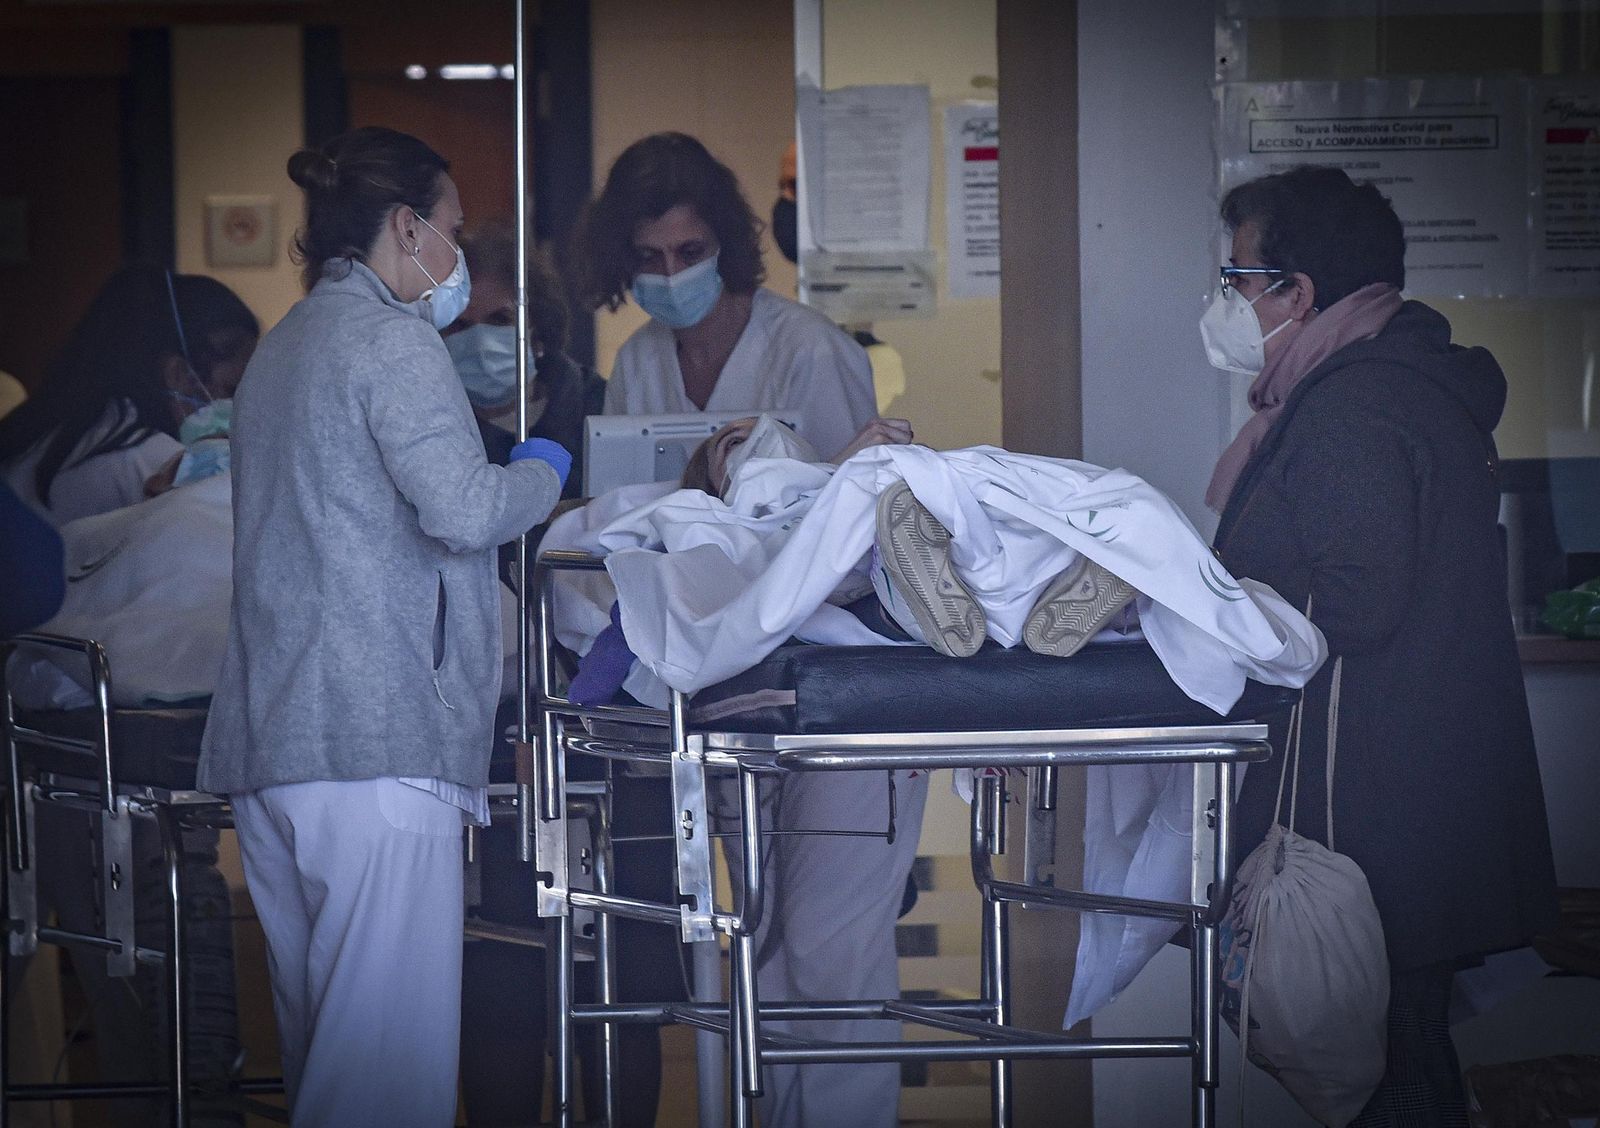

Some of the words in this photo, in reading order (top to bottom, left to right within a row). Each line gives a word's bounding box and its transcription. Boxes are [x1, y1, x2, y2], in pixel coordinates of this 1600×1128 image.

[1295, 124, 1330, 134] Nueva
[1333, 123, 1389, 133] Normativa
[1392, 122, 1425, 132] Covid
[1427, 123, 1453, 133] para
[1257, 138, 1304, 147] ACCESO
[1306, 139, 1313, 149] y
[1315, 135, 1422, 146] ACOMPAÑAMIENTO
[1424, 136, 1437, 145] de
[1440, 136, 1490, 146] pacientes
